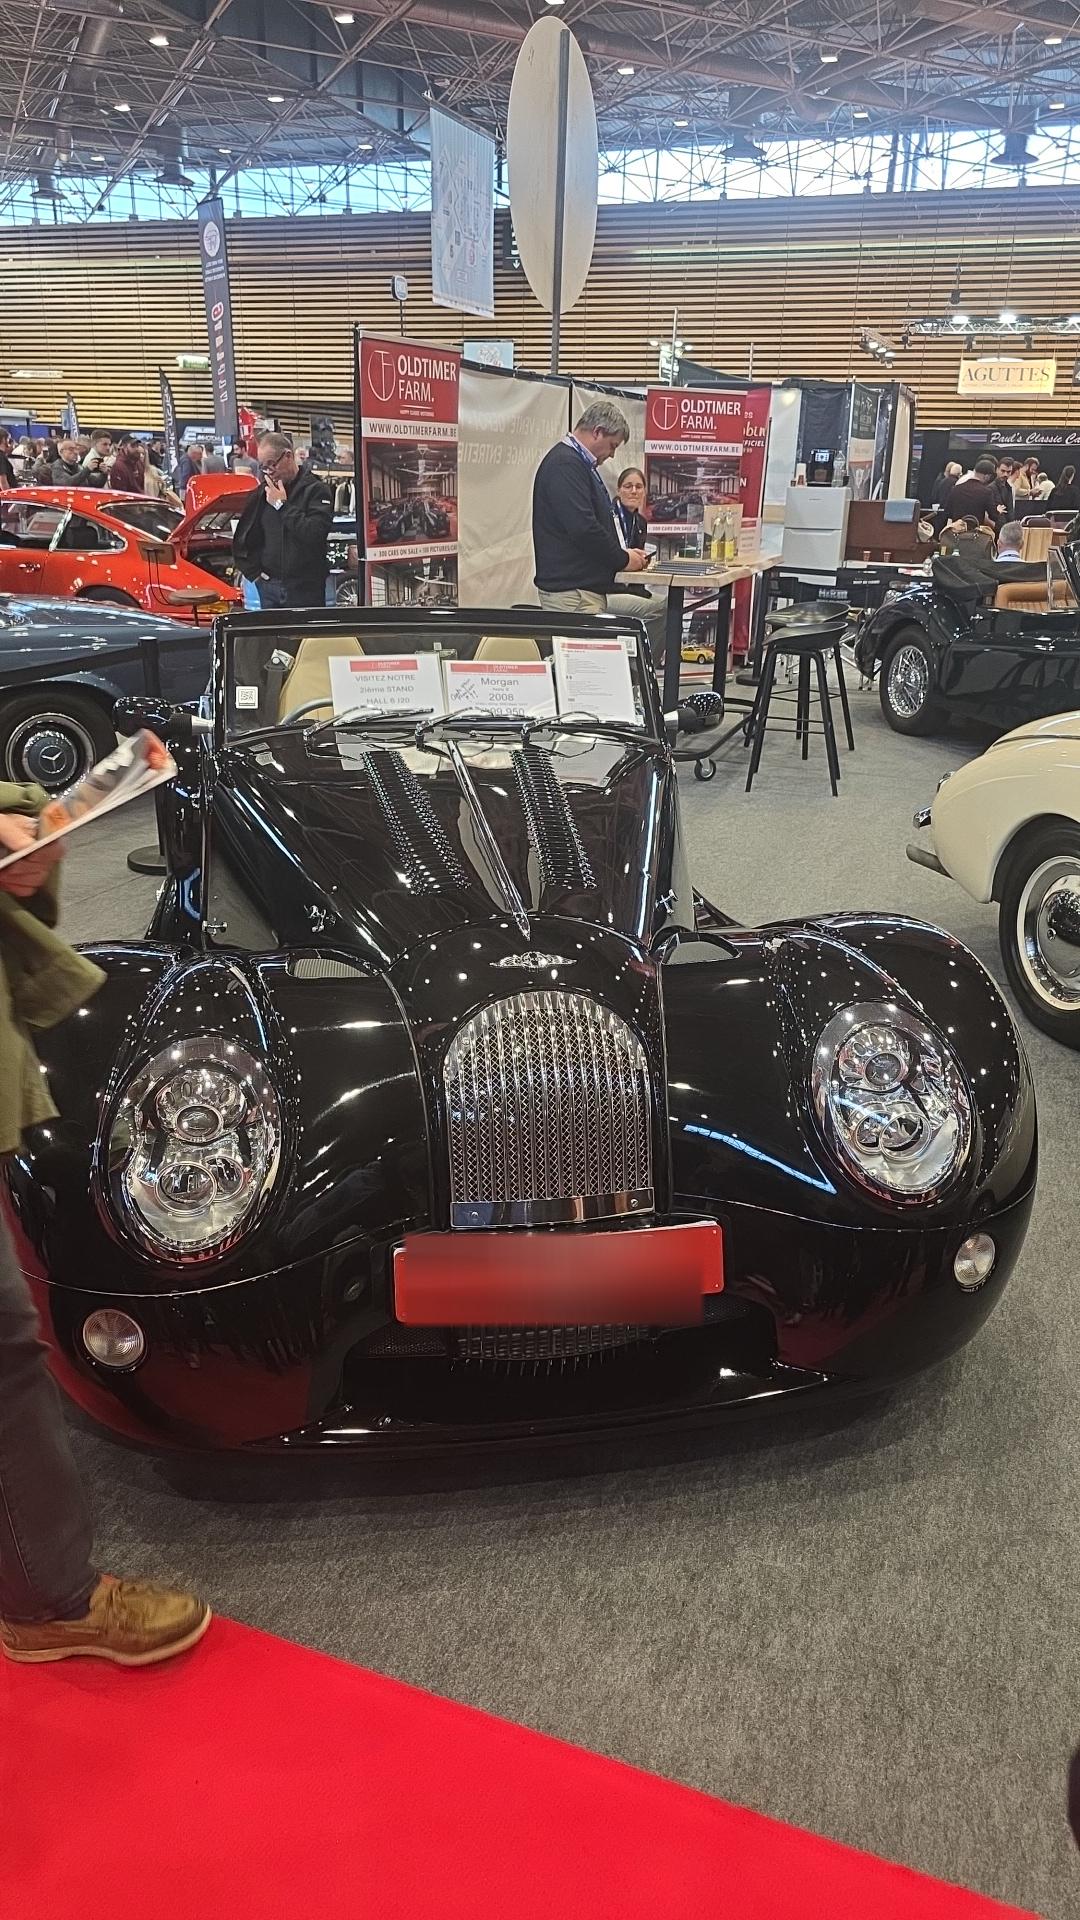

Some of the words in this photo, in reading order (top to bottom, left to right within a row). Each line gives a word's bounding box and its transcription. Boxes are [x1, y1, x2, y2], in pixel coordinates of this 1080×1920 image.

[397, 354, 457, 382] OLDTIMER
[962, 367, 1051, 382] AGUTTES
[398, 379, 435, 402] FARM.
[680, 398, 741, 416] OLDTIMER
[680, 414, 717, 430] FARM.
[369, 422, 457, 438] WWW.OLDTIMERFARM.BE
[990, 431, 1023, 443] Paul's
[1025, 432, 1063, 444] Classic
[1065, 432, 1080, 444] Ca
[650, 443, 739, 454] WWW.OLDTIMERFARM.BE
[399, 548, 407, 556] ON
[408, 547, 418, 555] SALE
[480, 677, 519, 687] Morgan
[386, 685, 414, 693] STAND
[366, 697, 389, 705] HALL
[488, 693, 514, 702] 2008
